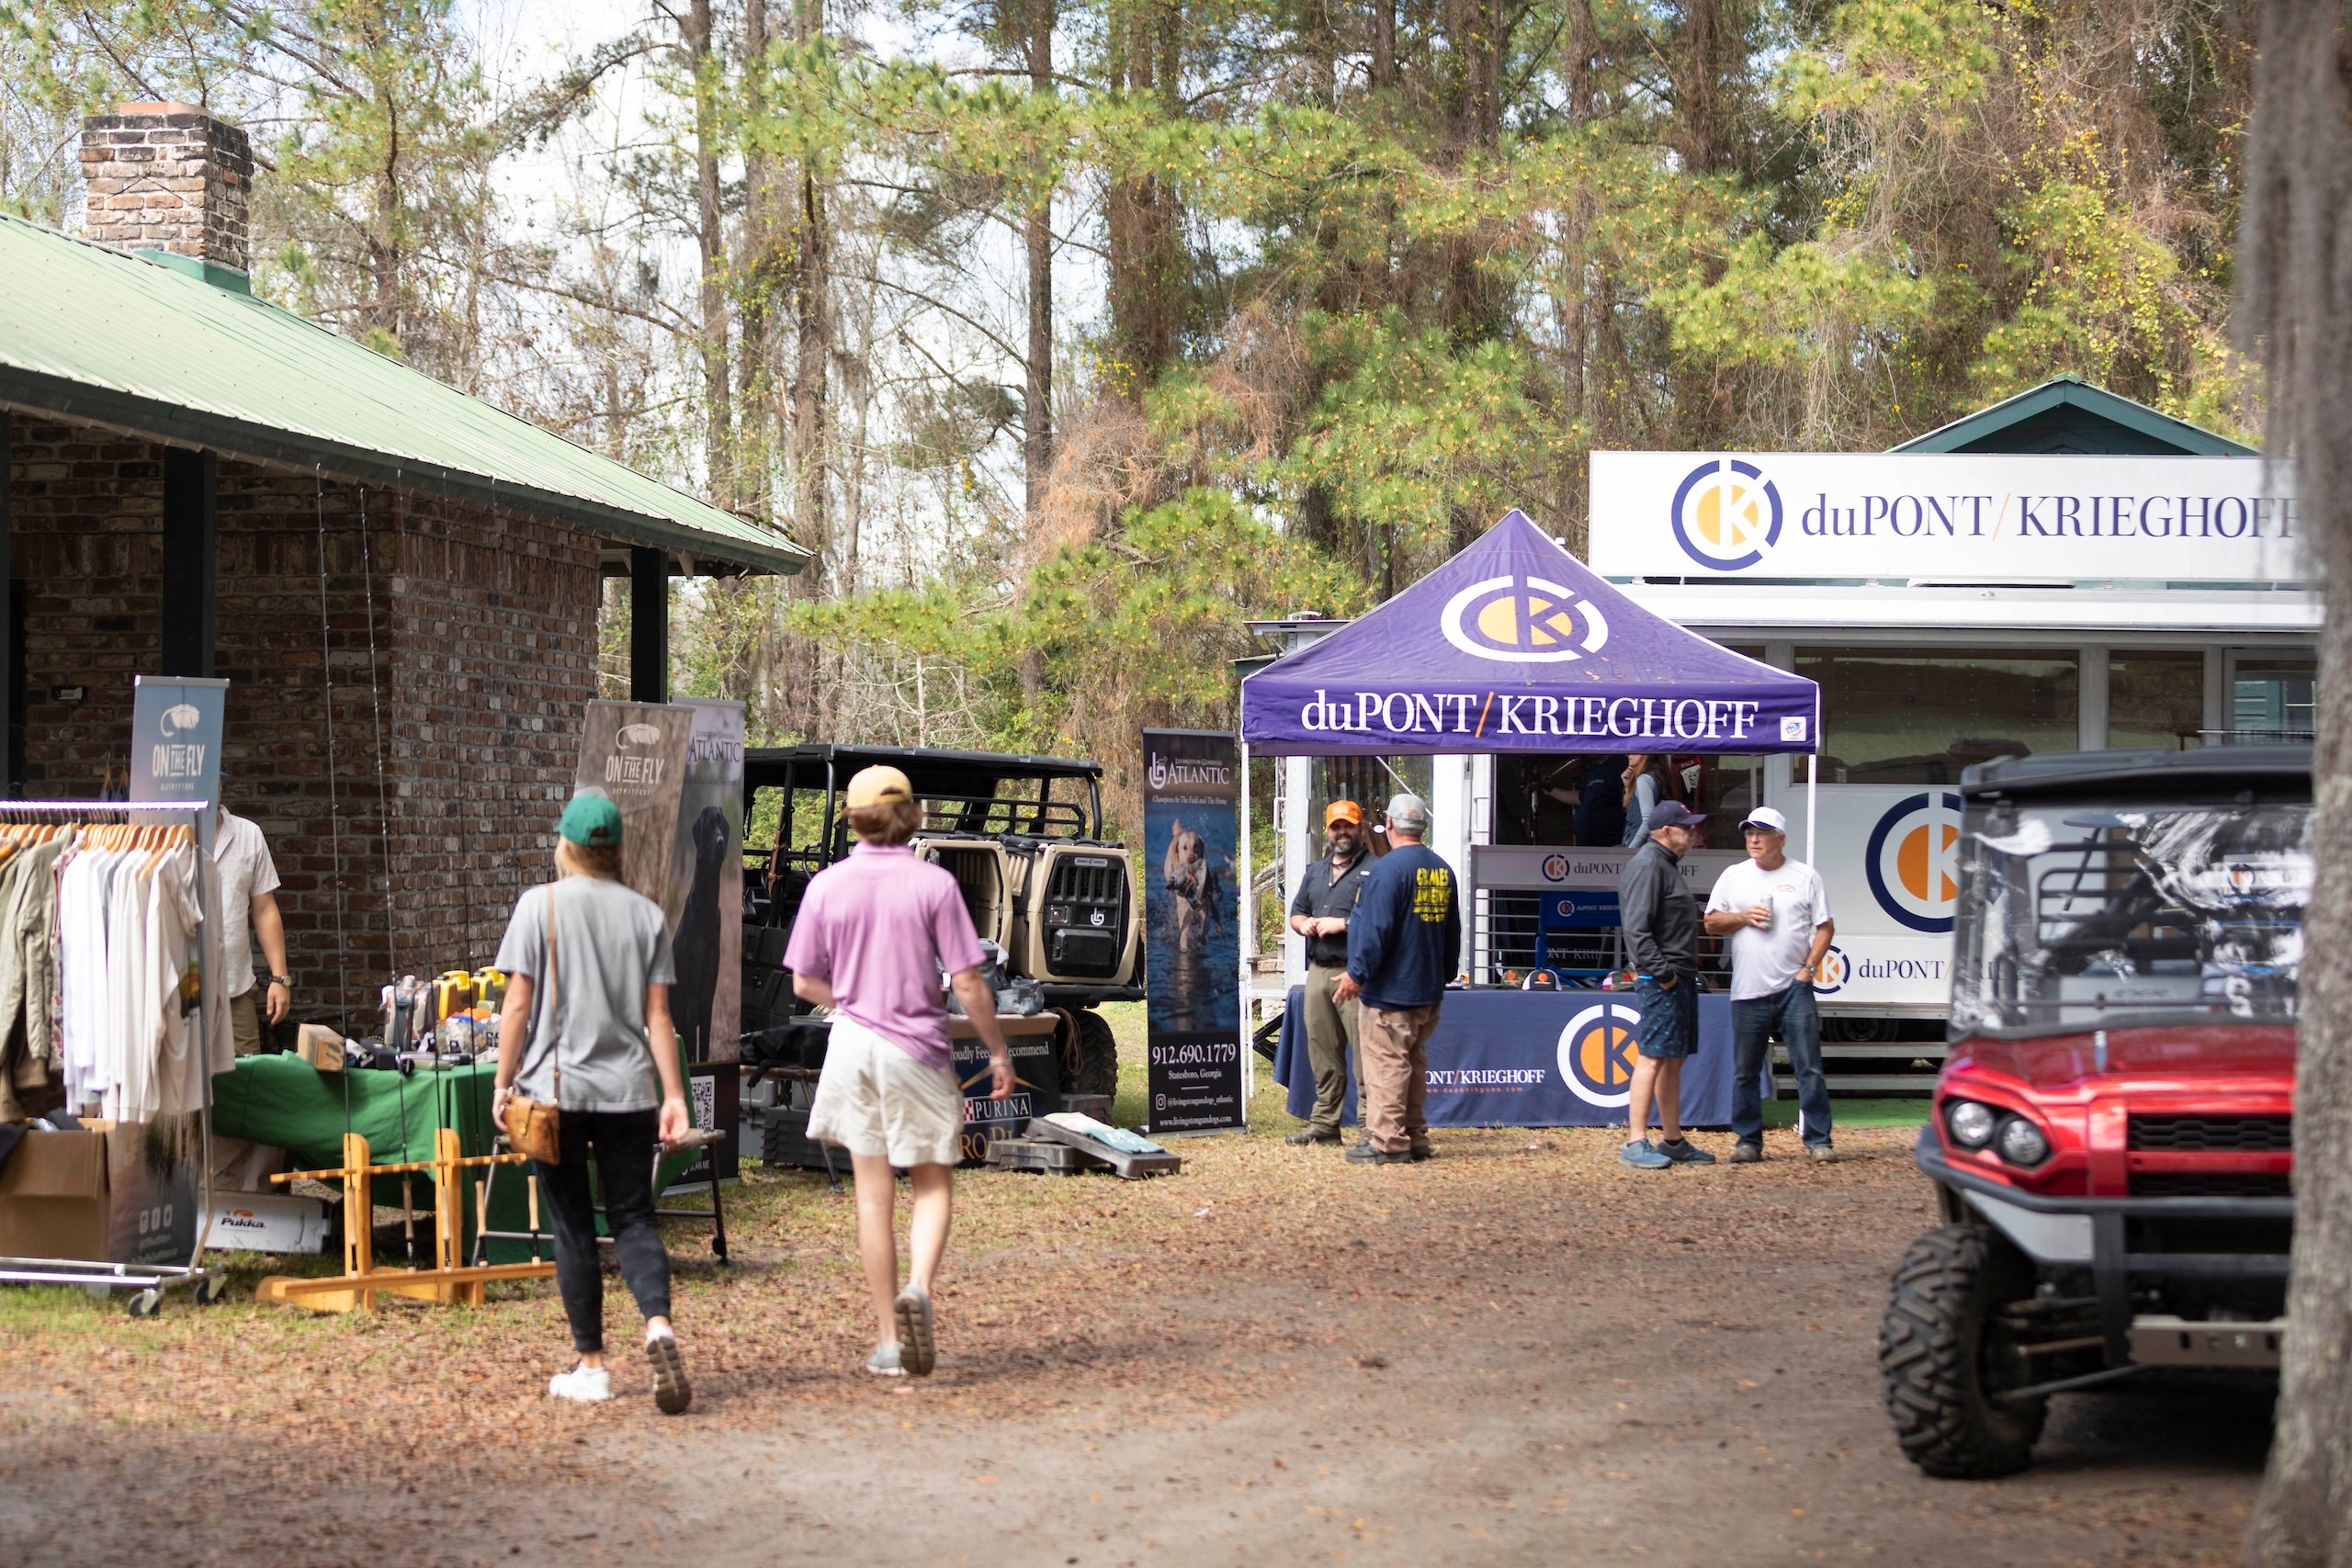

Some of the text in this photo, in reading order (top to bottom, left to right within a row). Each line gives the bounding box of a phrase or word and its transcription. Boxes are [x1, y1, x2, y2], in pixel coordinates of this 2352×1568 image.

[688, 737, 741, 762] ATLANTIC
[153, 744, 206, 778] ON THE FLY
[605, 755, 665, 784] ON THE FLY
[1167, 762, 1229, 784] ATLANTIC
[950, 1045, 975, 1064] roudly
[1006, 1041, 1049, 1057] ecommend
[1152, 1043, 1237, 1065] 912.690.1779
[1200, 1067, 1223, 1079] Georgia
[1425, 1068, 1545, 1086] ONT/KRIEGHOFF
[974, 1098, 1029, 1119] PURINA
[958, 1132, 989, 1159] RO
[220, 1217, 266, 1229] Pukka
